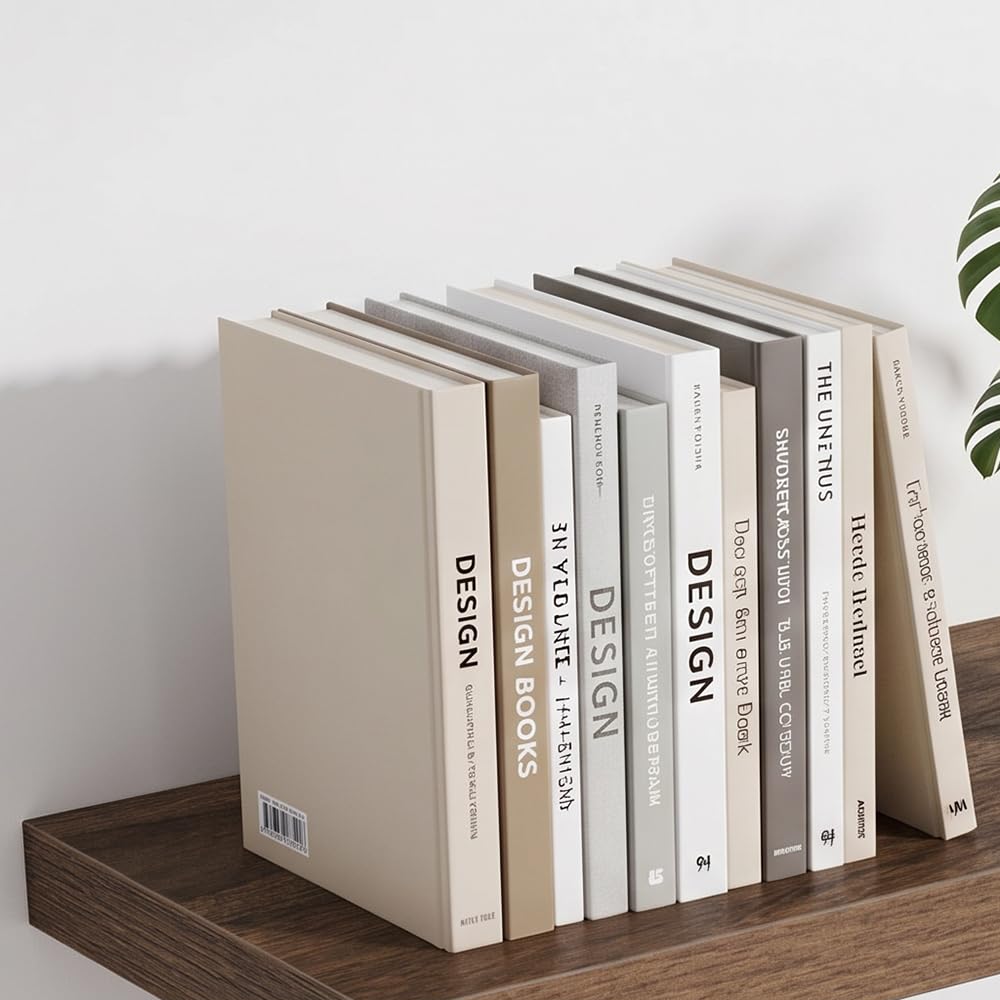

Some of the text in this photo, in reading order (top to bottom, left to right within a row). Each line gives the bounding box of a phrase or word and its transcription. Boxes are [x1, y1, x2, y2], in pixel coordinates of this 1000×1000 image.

[817, 361, 833, 402] THE
[455, 553, 479, 669] DESIGN
[511, 556, 538, 779] DESIGN BOOKS
[589, 585, 619, 740] DESIGN
[687, 548, 714, 704] DESIGN
